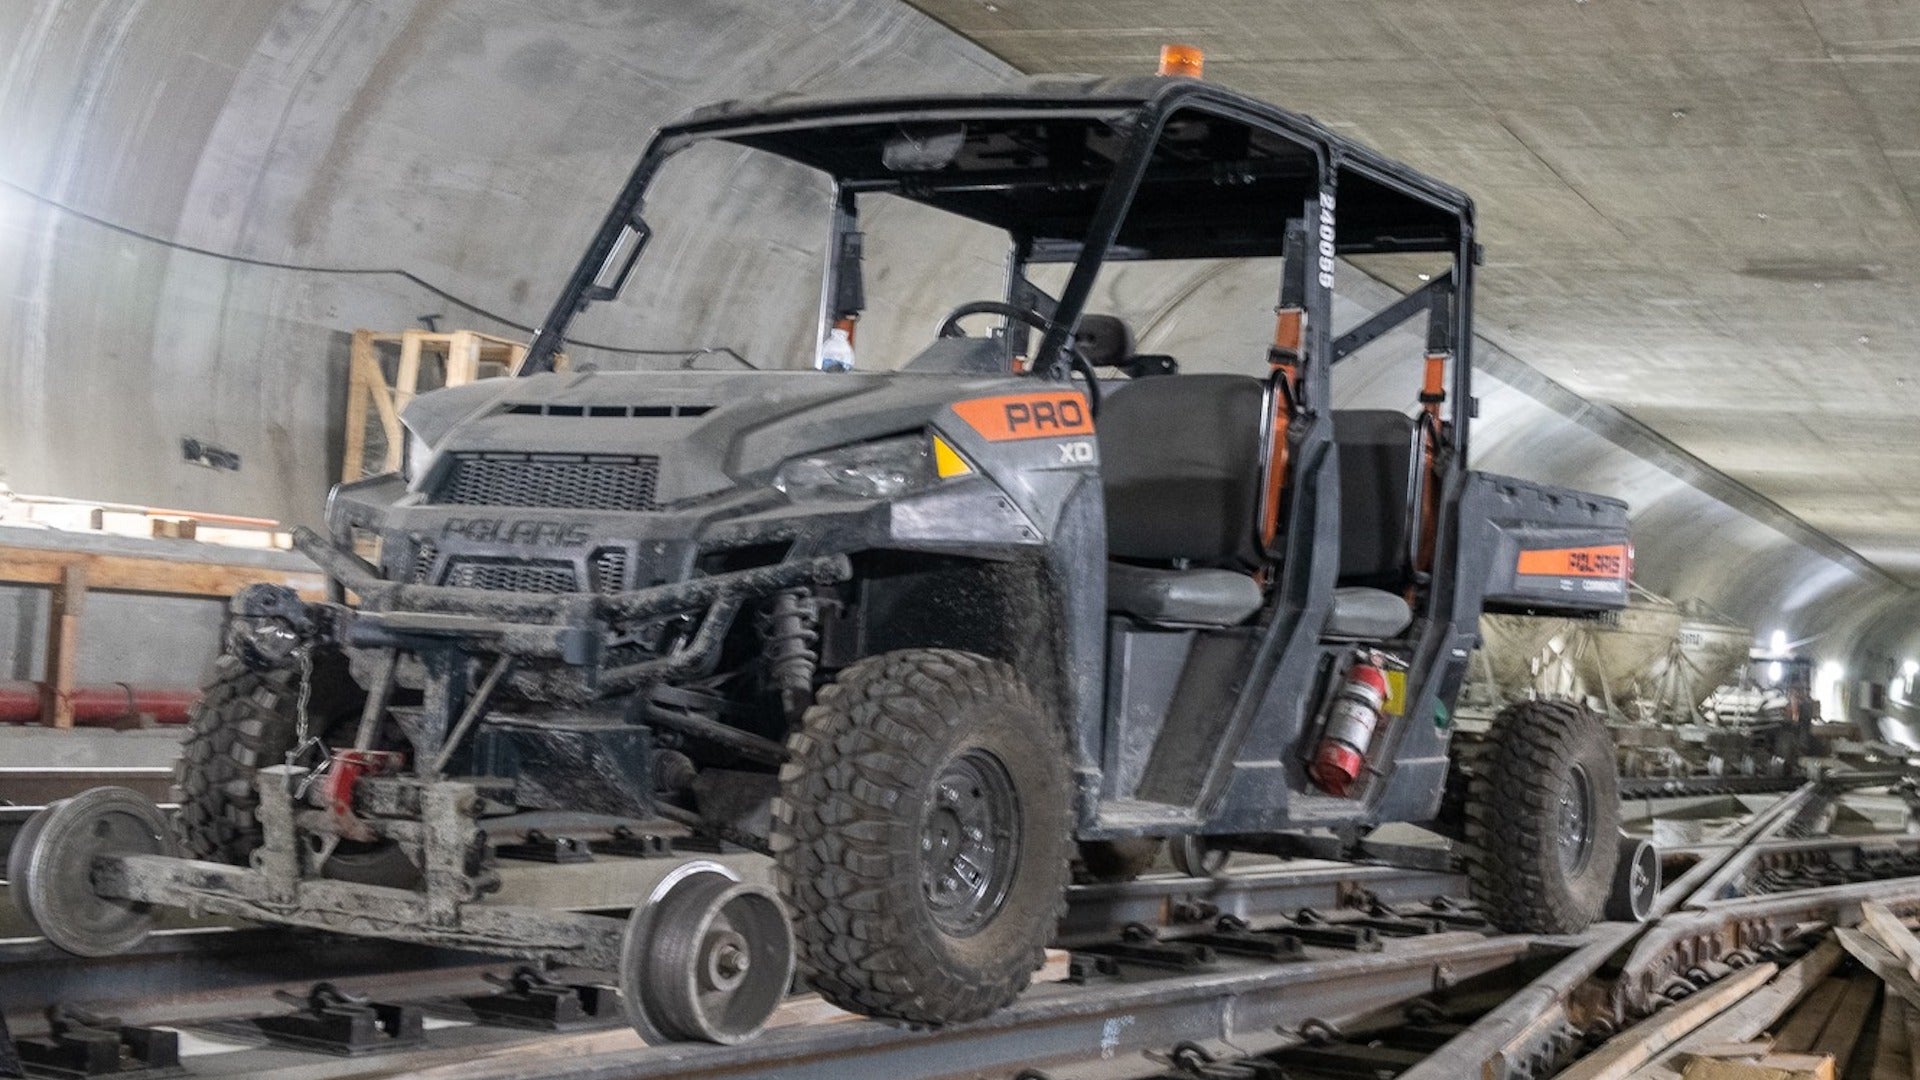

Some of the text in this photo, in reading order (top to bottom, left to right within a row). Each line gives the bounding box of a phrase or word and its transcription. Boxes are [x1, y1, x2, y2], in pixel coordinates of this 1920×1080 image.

[1319, 191, 1336, 290] 240055
[1005, 400, 1083, 432] PRO
[1057, 441, 1094, 464] XD
[440, 516, 593, 548] POLARIS
